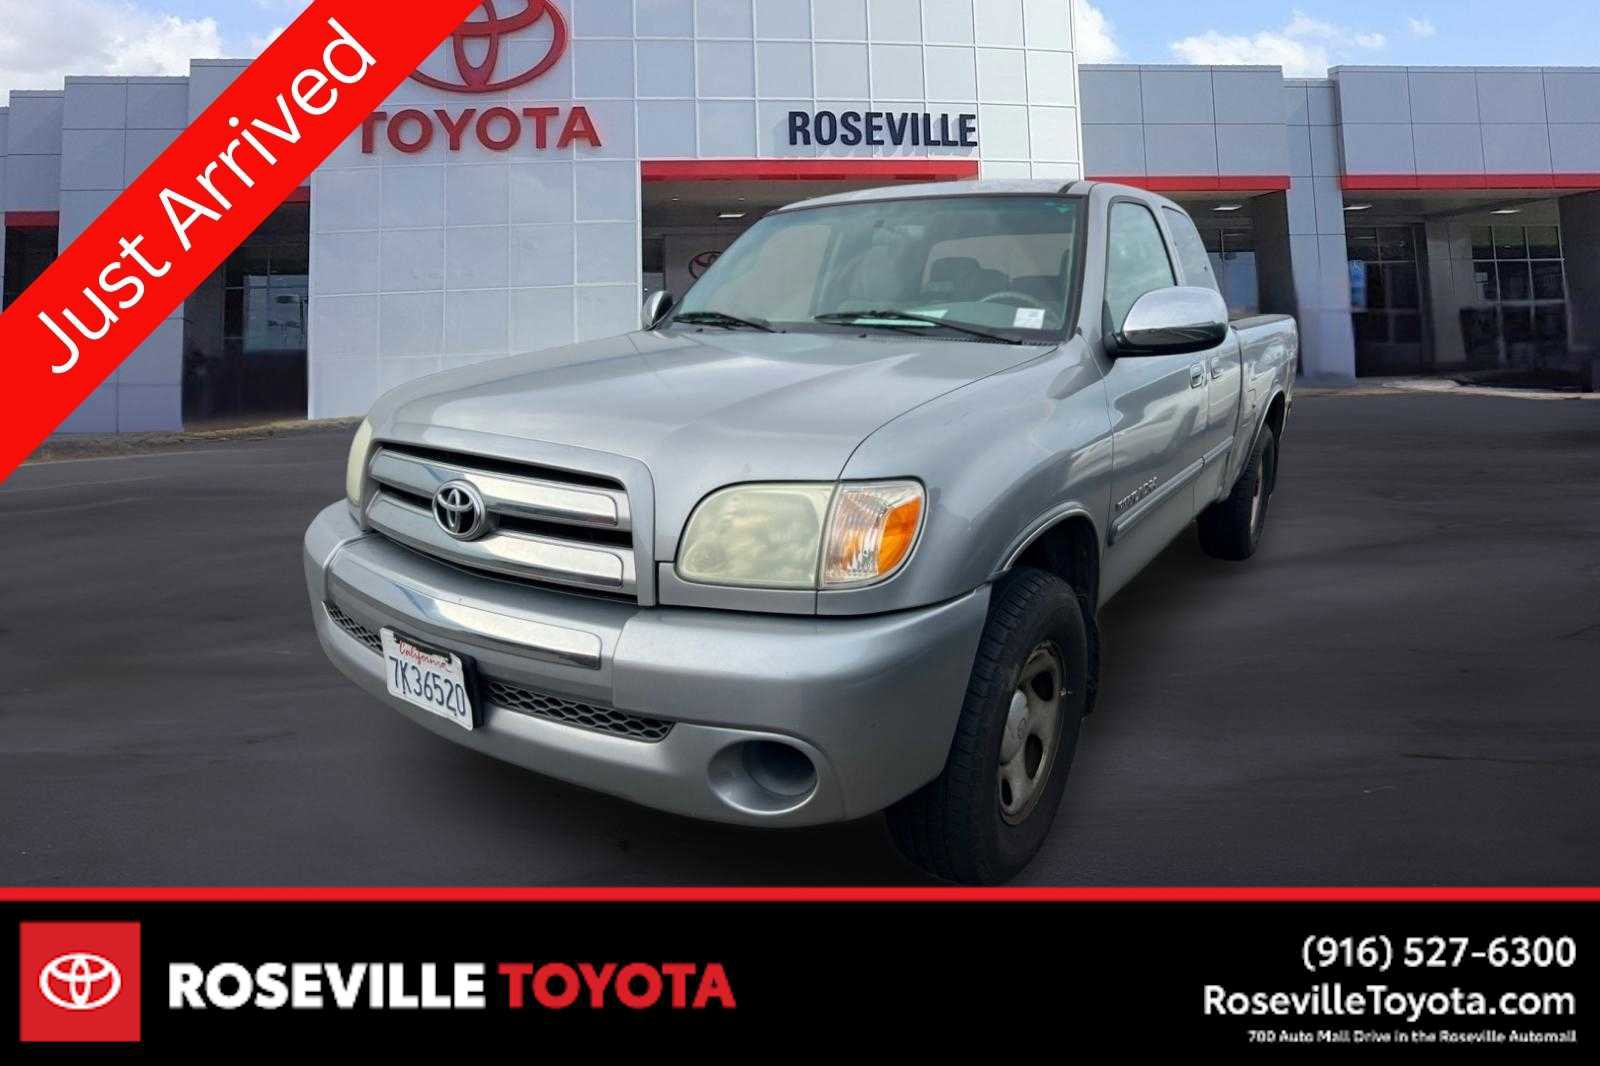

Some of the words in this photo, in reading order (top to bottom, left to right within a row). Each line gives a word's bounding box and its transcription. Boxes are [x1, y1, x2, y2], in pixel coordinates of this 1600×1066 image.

[361, 106, 603, 154] TOYOTA
[788, 111, 978, 147] ROSEVILLE
[388, 655, 467, 717] 7K36520
